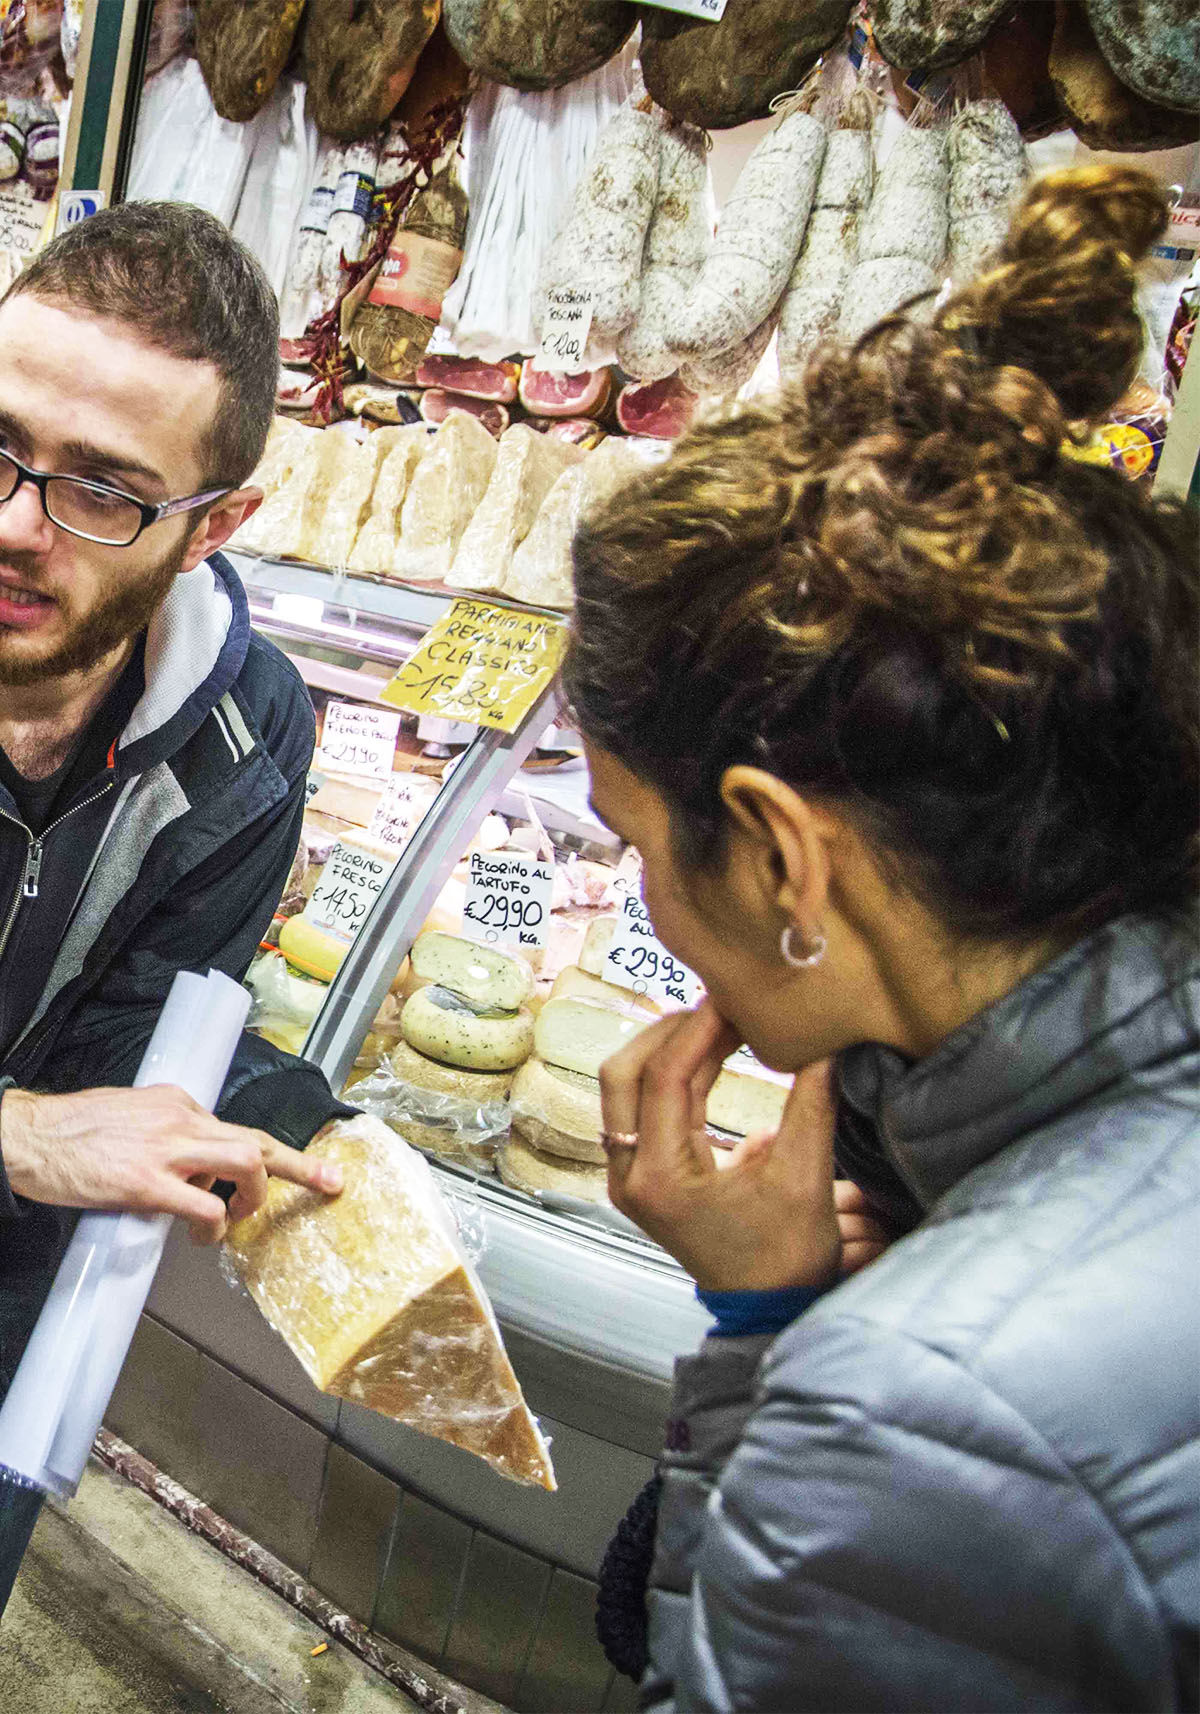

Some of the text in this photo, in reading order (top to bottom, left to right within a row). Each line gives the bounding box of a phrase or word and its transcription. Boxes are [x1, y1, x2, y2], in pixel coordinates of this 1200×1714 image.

[451, 600, 558, 636] PARMIGIANO
[445, 621, 538, 654] REGGIANO
[427, 641, 538, 675] CLASSICO
[330, 704, 380, 724] PECORINO
[331, 843, 384, 874] PECORINO
[471, 853, 552, 880] PECORINO AL
[332, 864, 382, 892] FRESCO
[471, 872, 531, 895] TARTUFO
[463, 894, 543, 931] €29,90
